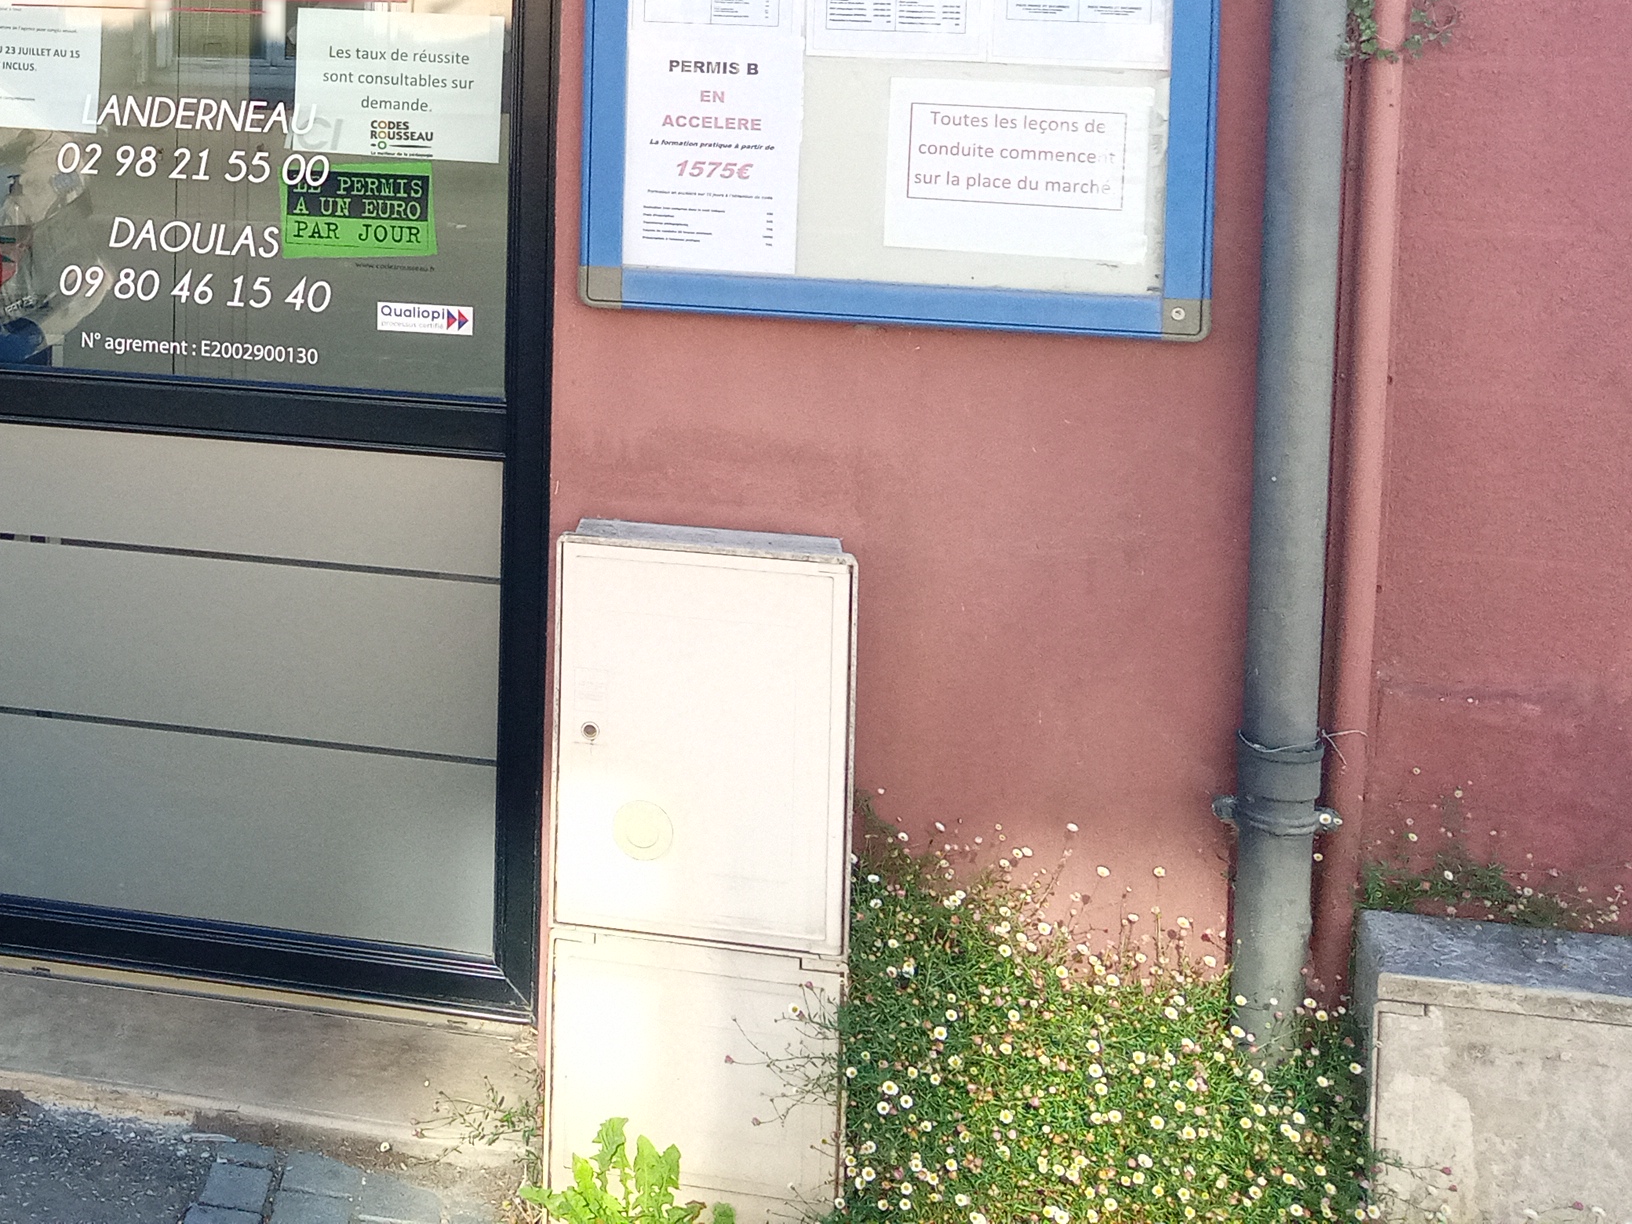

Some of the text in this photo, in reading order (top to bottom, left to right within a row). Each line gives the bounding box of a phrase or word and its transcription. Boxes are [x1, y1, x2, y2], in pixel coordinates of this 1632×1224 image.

[5, 46, 16, 55] 23
[18, 46, 51, 57] JUILLET
[53, 48, 67, 57] AU
[70, 49, 81, 58] 15
[329, 46, 470, 65] Les taux de réussite
[2, 61, 37, 71] INCLUS.
[669, 60, 759, 75] PERMIS B
[322, 72, 475, 90] sont consultables sur
[361, 96, 433, 112] demande.
[700, 90, 725, 104] EN
[81, 94, 318, 135] LANDERNEAU
[662, 114, 762, 131] ACCELERE
[930, 111, 1106, 134] Toutes les leçons de
[370, 120, 409, 130] CODES
[370, 130, 434, 142] ROUSSEAU
[661, 139, 698, 147] formation
[918, 142, 1116, 164] conduite commencet
[57, 142, 330, 186] 02 98 21 55 00
[676, 159, 754, 180] 1575€
[336, 176, 423, 198] PERMIS
[914, 172, 941, 184] sur
[946, 171, 960, 186] la
[966, 173, 1011, 190] place
[1017, 176, 1038, 191] du
[293, 196, 421, 220] A UN EURO
[109, 216, 280, 258] DAOULAS
[293, 220, 421, 244] PAR JOUR
[59, 265, 332, 312] 09 80 46 15 40
[381, 305, 444, 321] Qualiopi
[81, 332, 101, 349] N°
[104, 336, 187, 355] agrement
[200, 340, 318, 364] E2002900130
